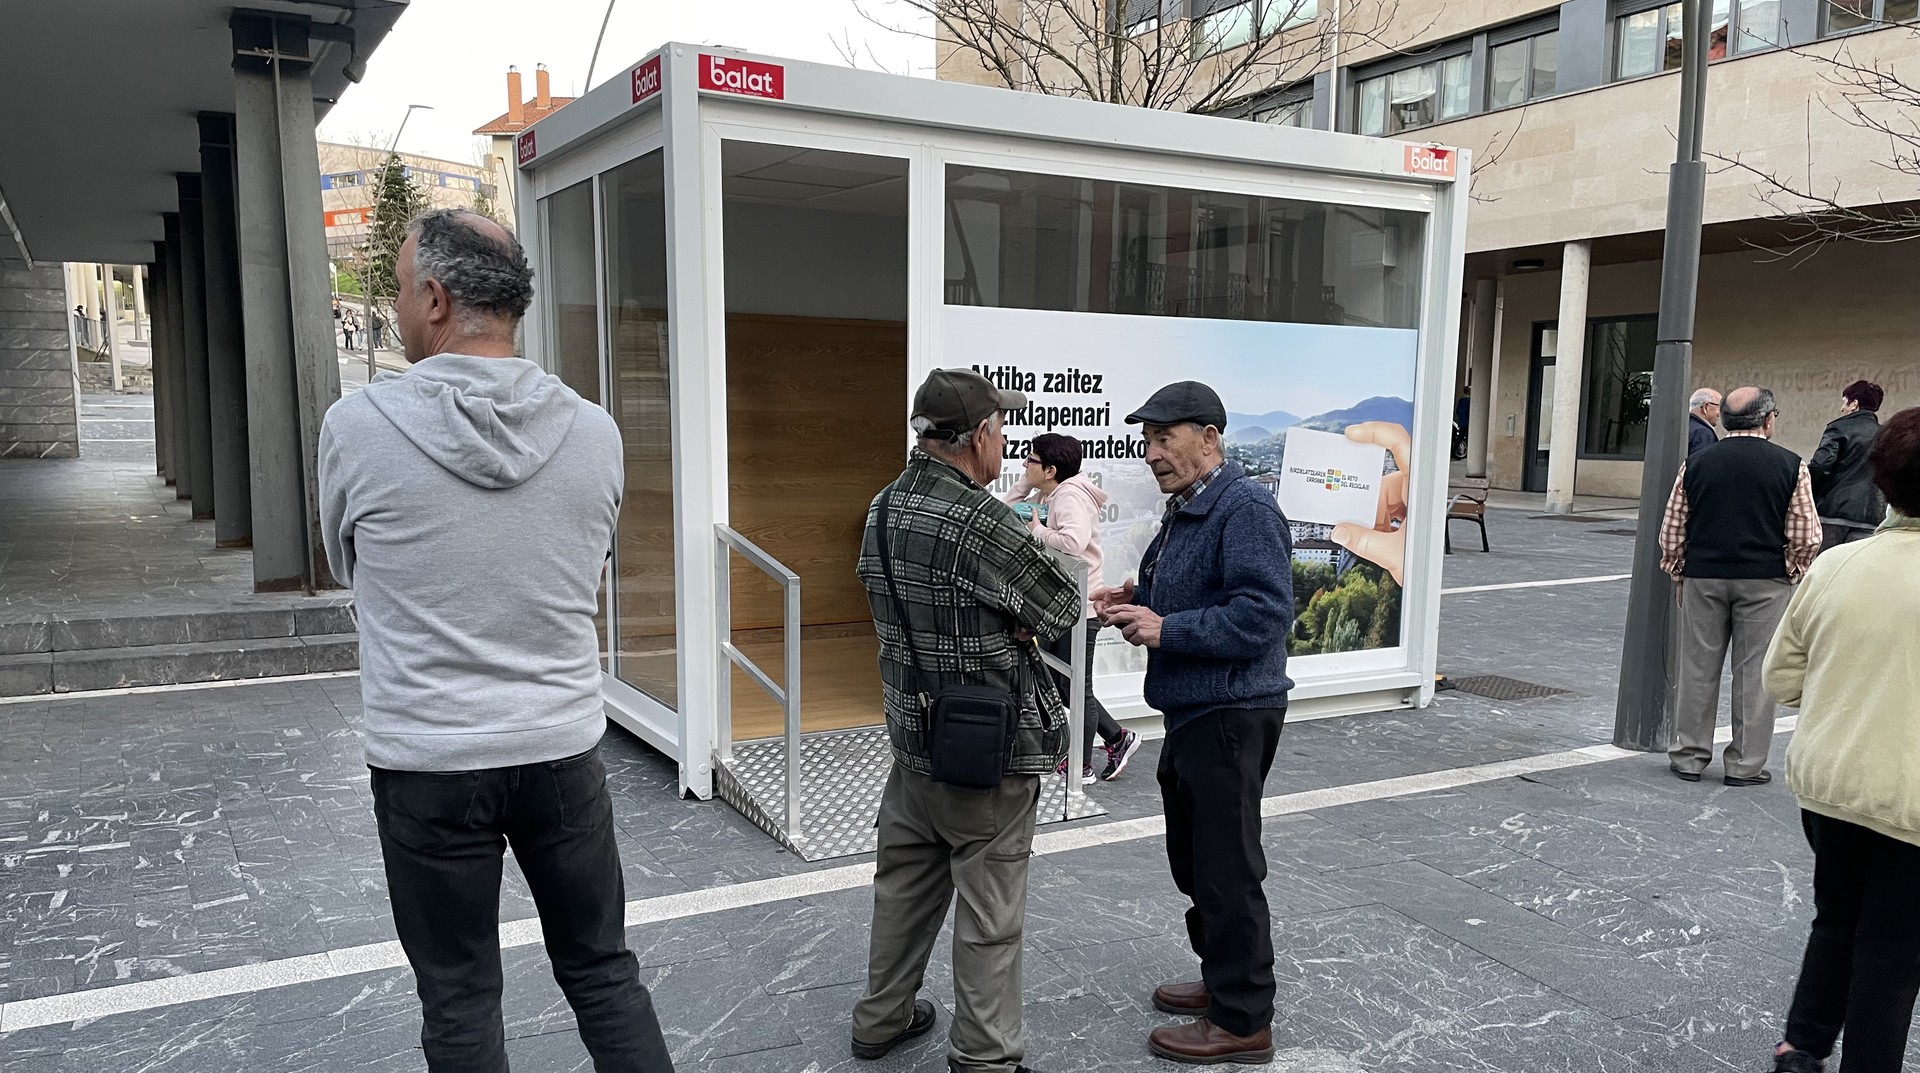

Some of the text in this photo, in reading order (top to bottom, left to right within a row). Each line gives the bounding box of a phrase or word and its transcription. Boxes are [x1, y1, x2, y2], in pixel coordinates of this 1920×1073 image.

[635, 67, 657, 97] balat
[710, 56, 773, 93] balat
[1411, 147, 1449, 172] balat
[972, 365, 1103, 394] ktiba zaitez
